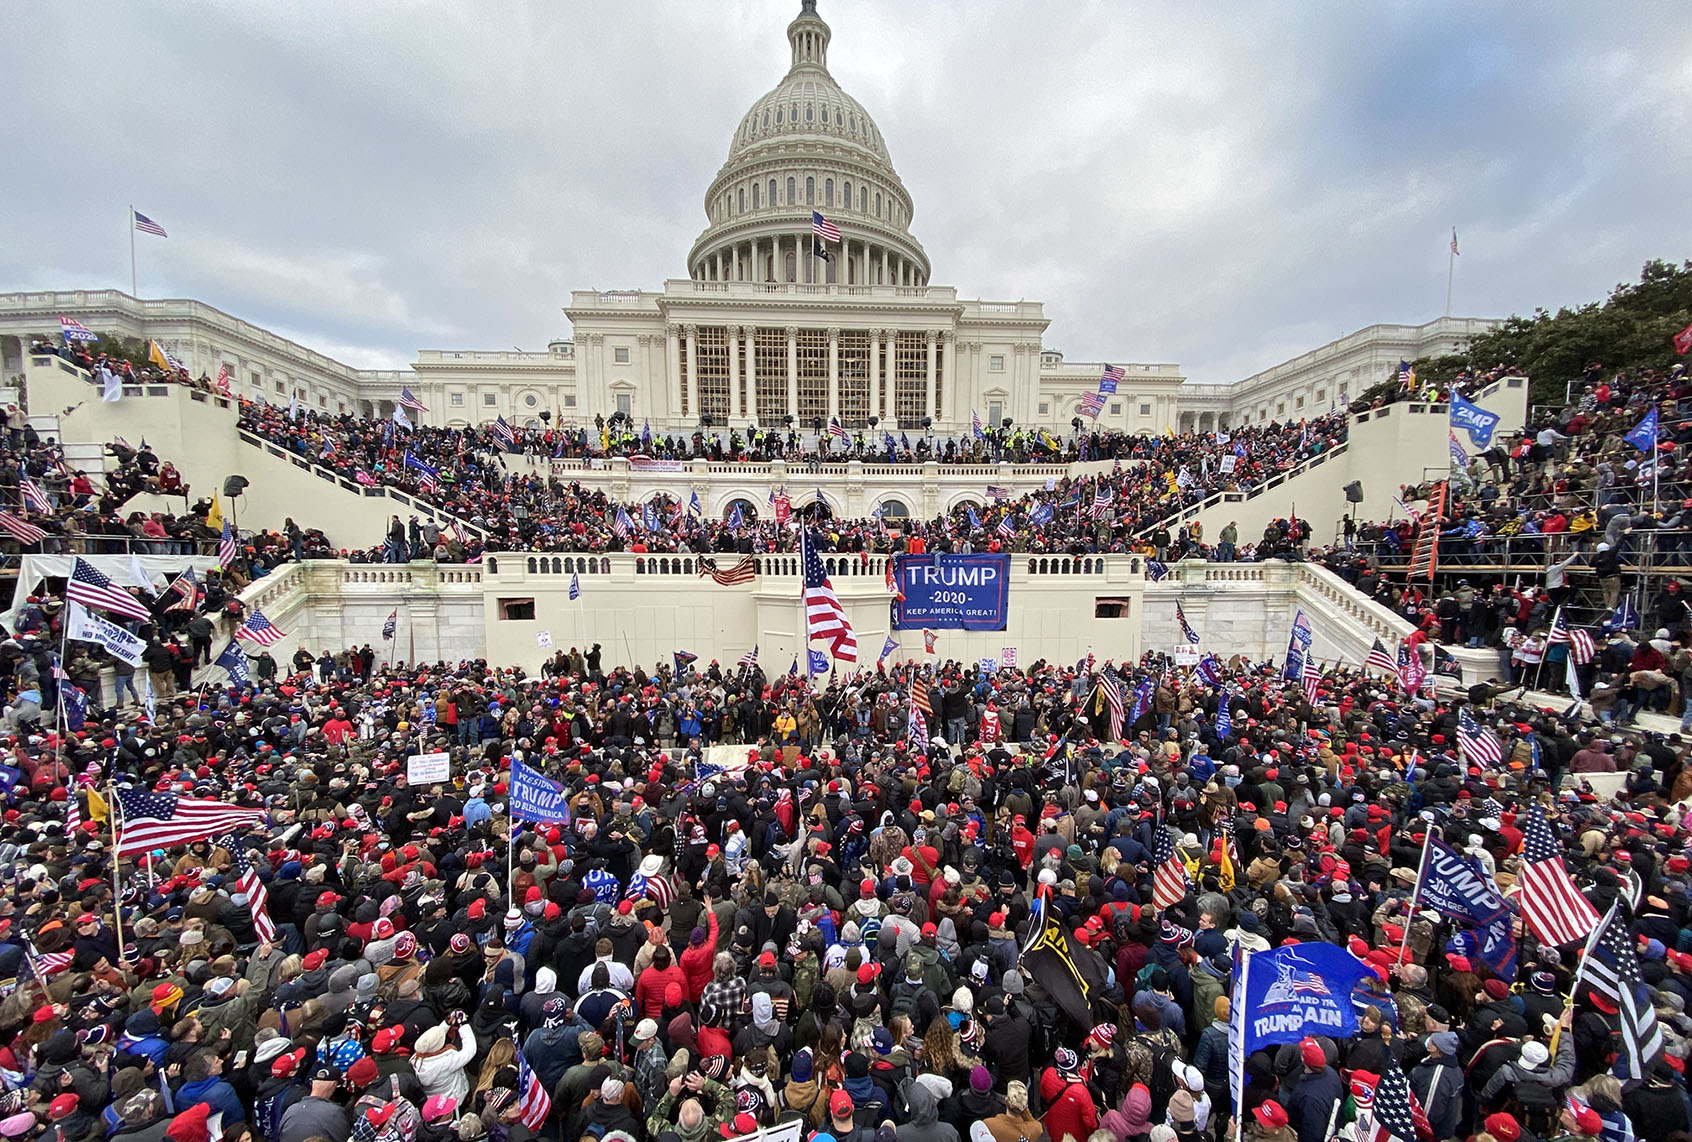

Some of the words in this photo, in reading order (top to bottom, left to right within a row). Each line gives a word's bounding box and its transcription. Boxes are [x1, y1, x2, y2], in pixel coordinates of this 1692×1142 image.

[906, 566, 997, 587] TRUMP
[966, 608, 997, 616] GREAT!
[82, 630, 93, 639] NO
[106, 642, 137, 661] BULLSHIT
[513, 781, 562, 810] TRUMP
[1430, 846, 1502, 910] RUMP
[1254, 1014, 1304, 1038] TRUMP
[1304, 1006, 1342, 1028] AIN
